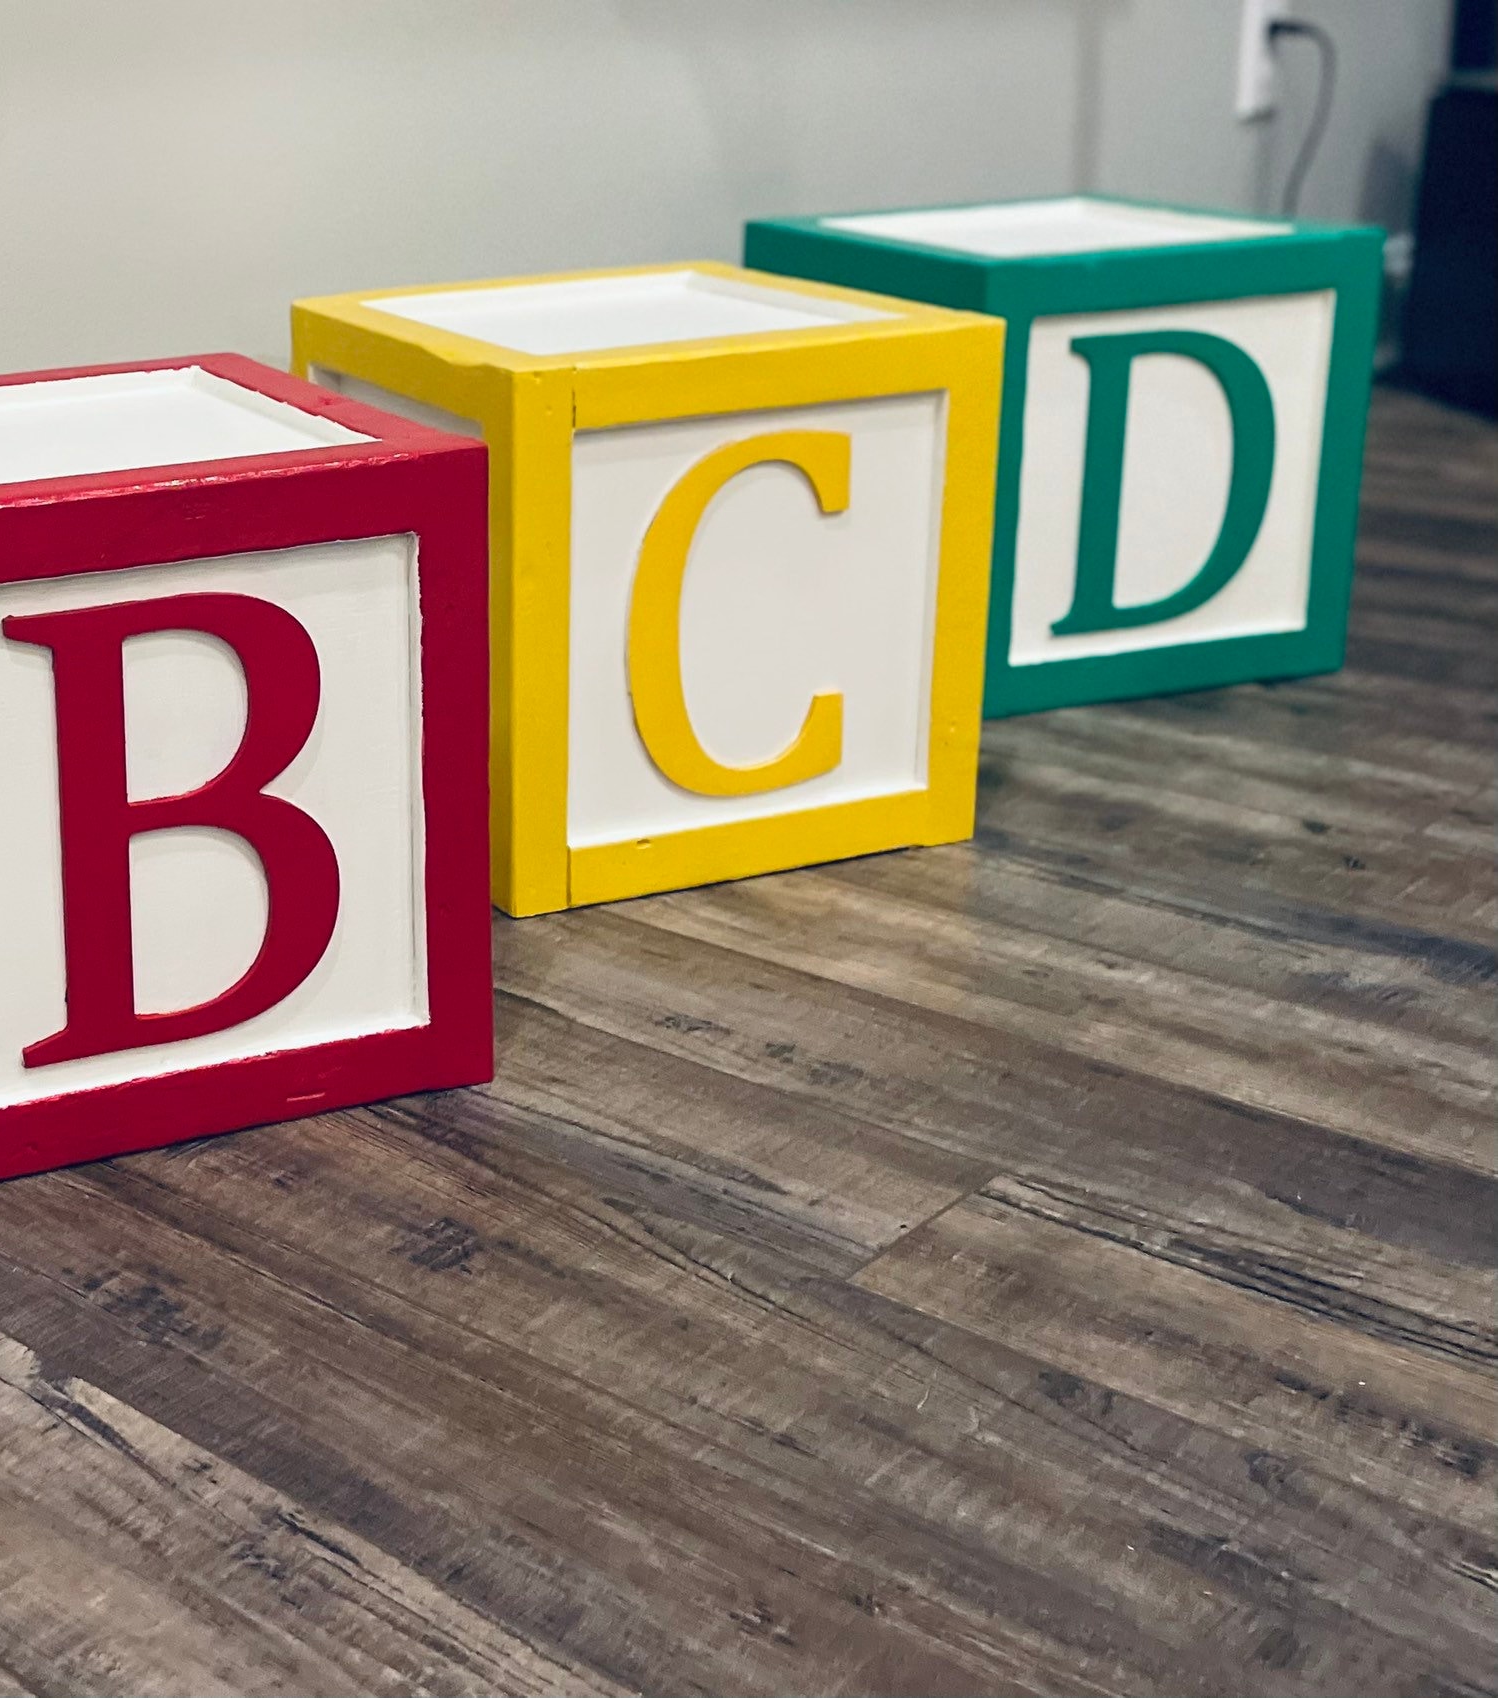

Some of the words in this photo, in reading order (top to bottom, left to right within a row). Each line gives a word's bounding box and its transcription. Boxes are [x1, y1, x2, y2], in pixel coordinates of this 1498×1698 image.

[628, 430, 851, 797] C
[1051, 331, 1274, 635] D
[2, 592, 339, 1069] B
